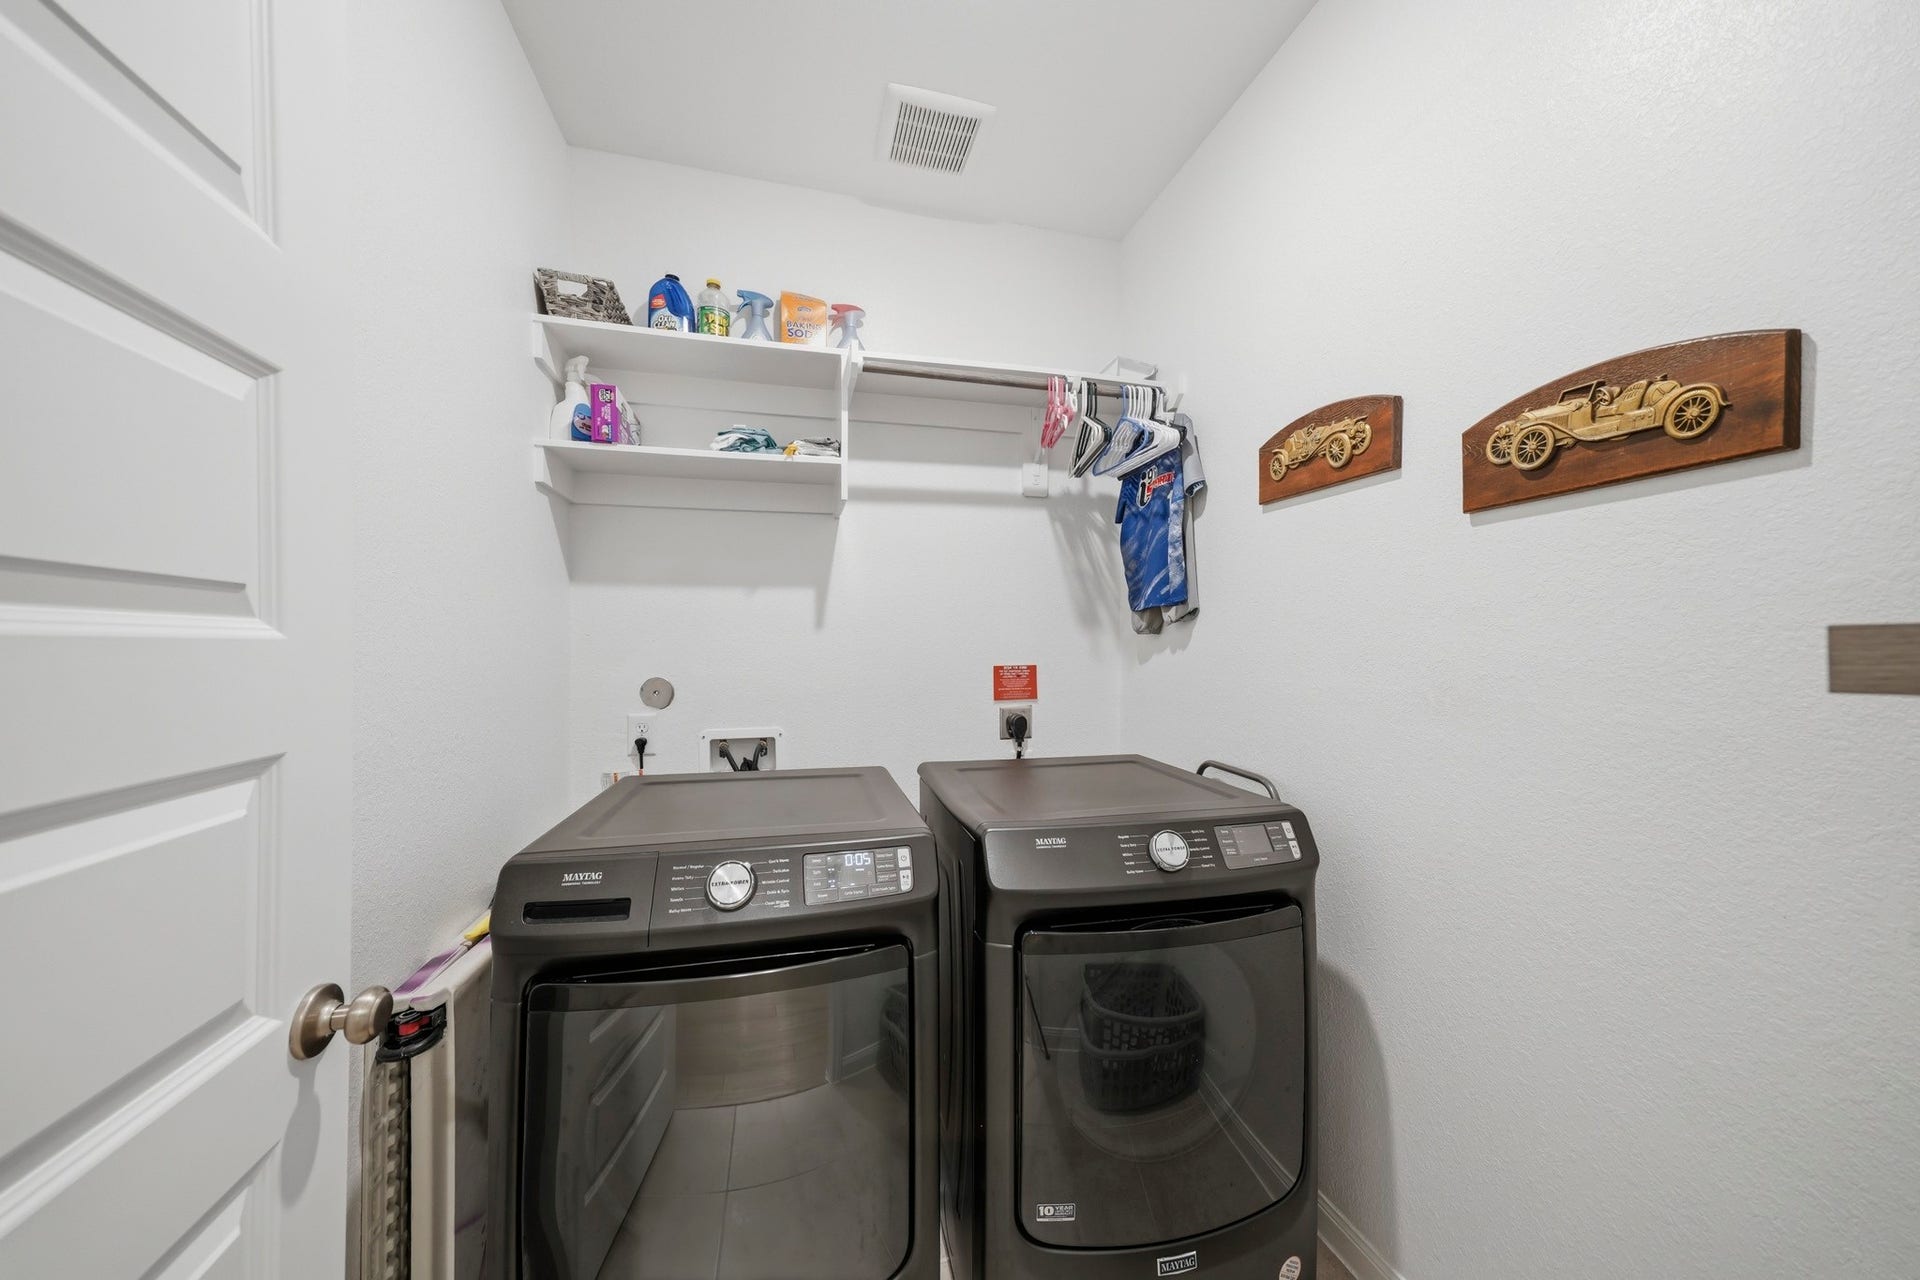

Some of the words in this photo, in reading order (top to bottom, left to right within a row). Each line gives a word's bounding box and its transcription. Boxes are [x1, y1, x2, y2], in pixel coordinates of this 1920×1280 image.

[787, 327, 818, 339] SOD
[1035, 837, 1067, 846] MAYTAG
[562, 871, 603, 882] MAYTAG
[1038, 1205, 1055, 1217] 10
[1161, 1256, 1195, 1273] MAYTAG
